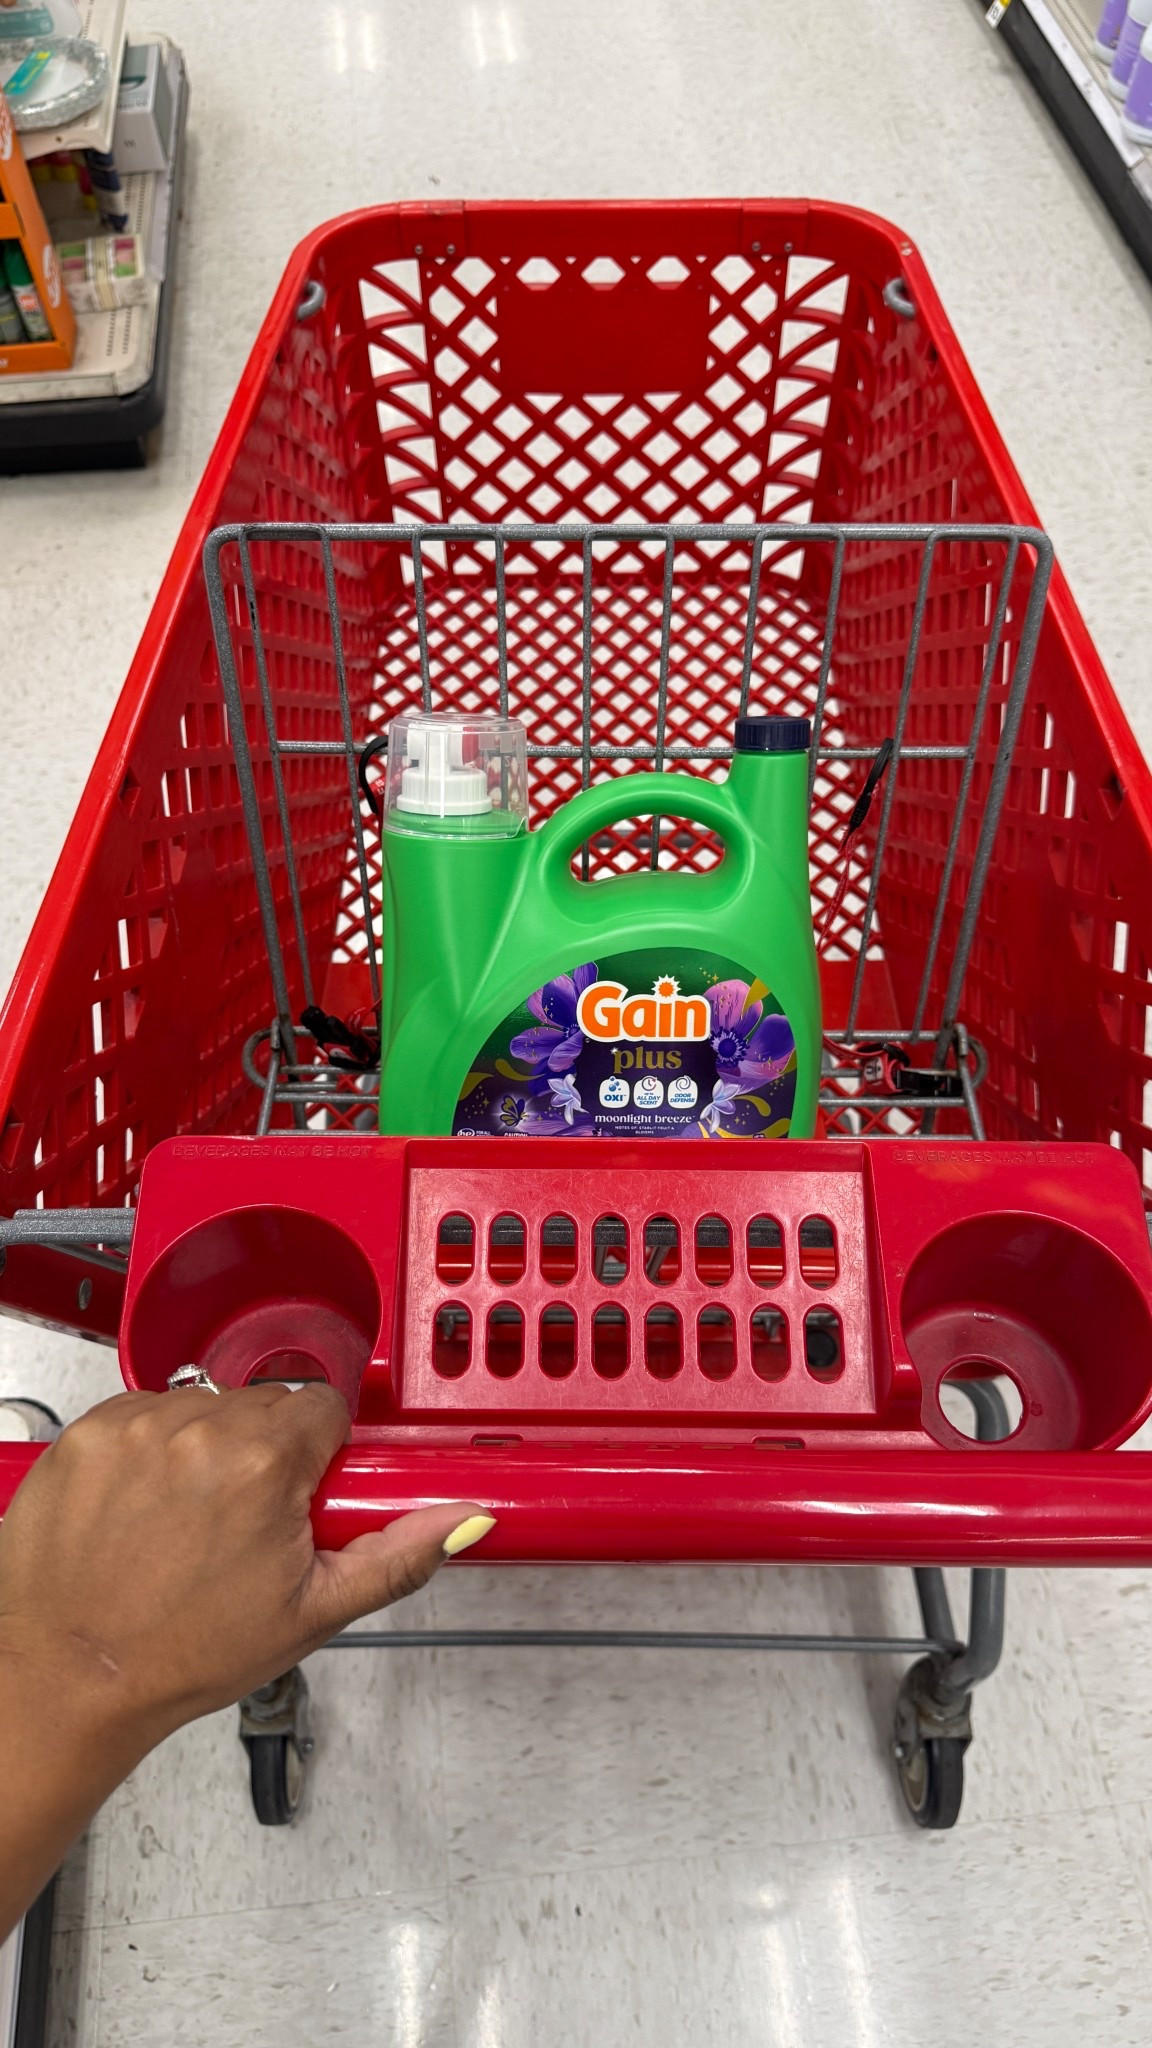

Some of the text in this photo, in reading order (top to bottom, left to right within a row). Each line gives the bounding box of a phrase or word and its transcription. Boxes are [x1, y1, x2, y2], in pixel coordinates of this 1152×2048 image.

[579, 980, 709, 1040] Gain
[613, 1046, 682, 1074] plus
[594, 1113, 692, 1125] moonlight breeze
[172, 1144, 372, 1157] BEVERAGES MAY BE HOT
[894, 1150, 1096, 1164] BEVERAGES MAY BE HOT
